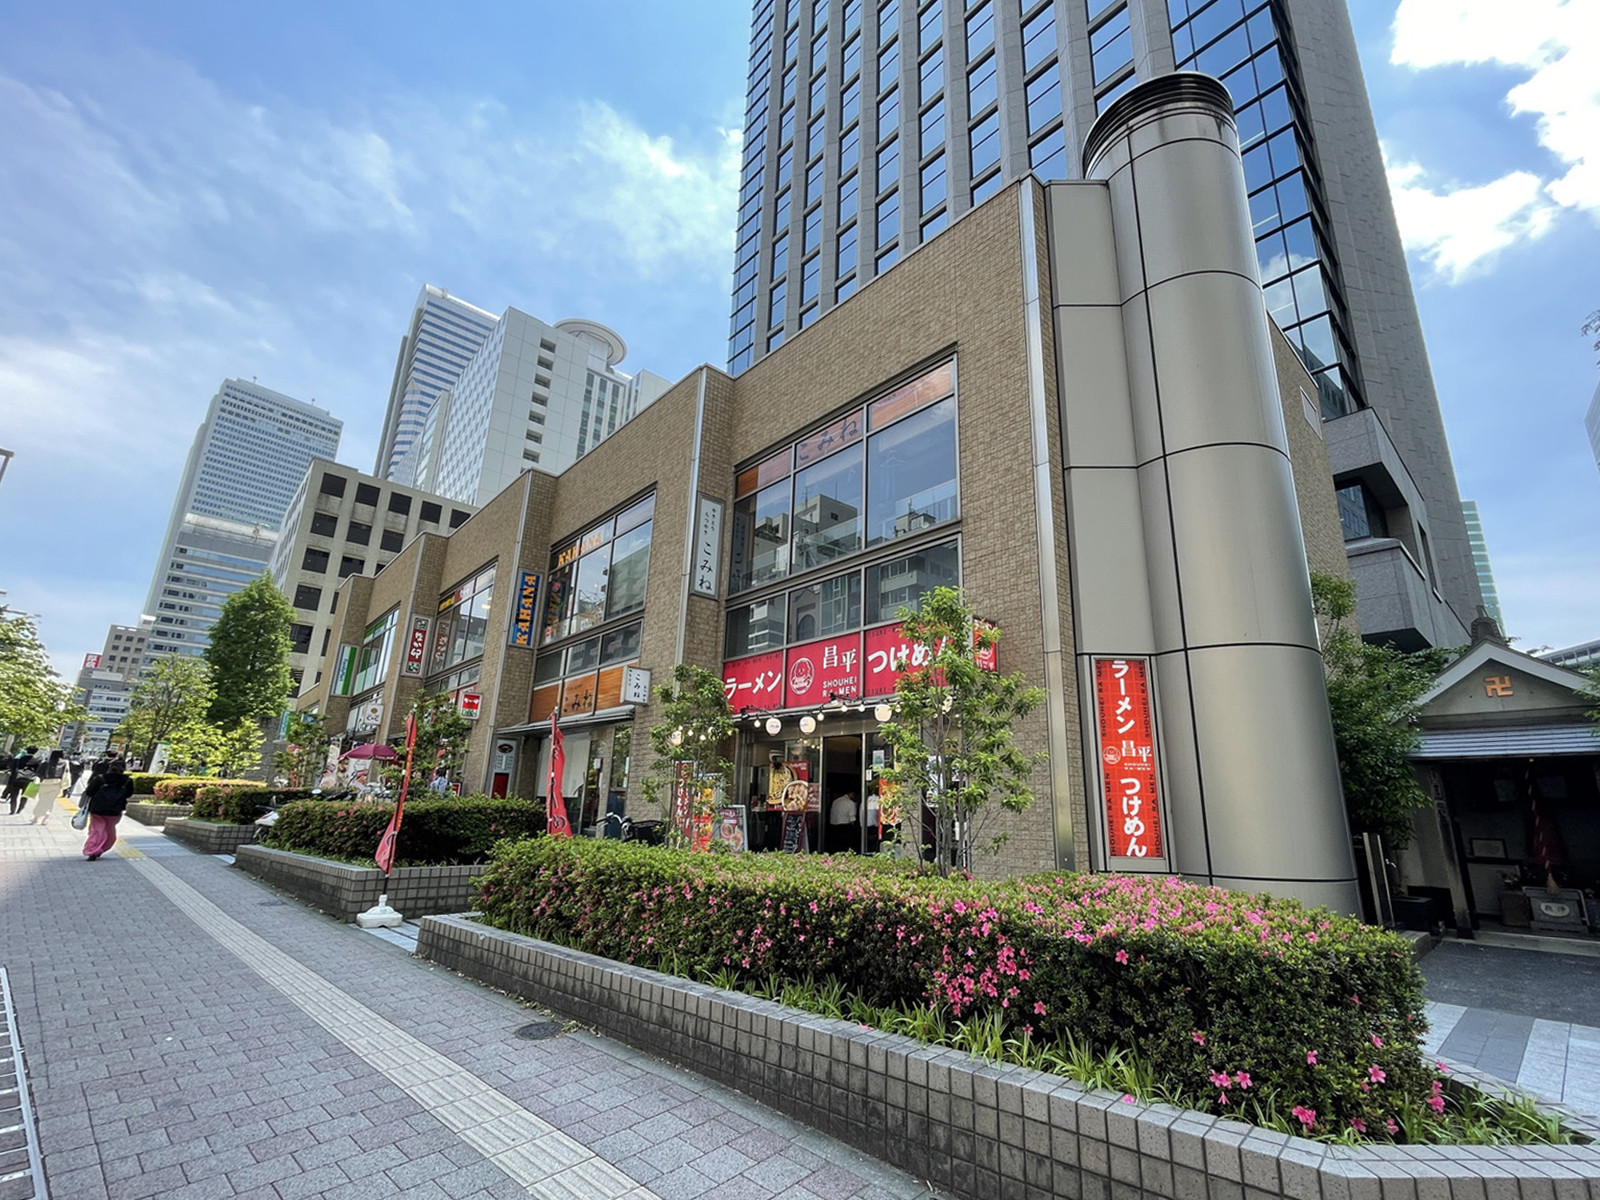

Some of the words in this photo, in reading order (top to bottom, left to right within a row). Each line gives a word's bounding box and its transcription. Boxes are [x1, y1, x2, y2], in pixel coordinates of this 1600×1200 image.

[800, 418, 858, 462] こみね
[699, 541, 713, 591] こみね
[515, 575, 537, 646] KAHANA
[822, 645, 857, 674] 昌平
[725, 670, 782, 700] ラーメン
[822, 676, 857, 689] SHOUHEI
[1112, 660, 1135, 734] ラーメン
[1121, 740, 1152, 763] 昌平
[1120, 777, 1147, 857] つけめん
